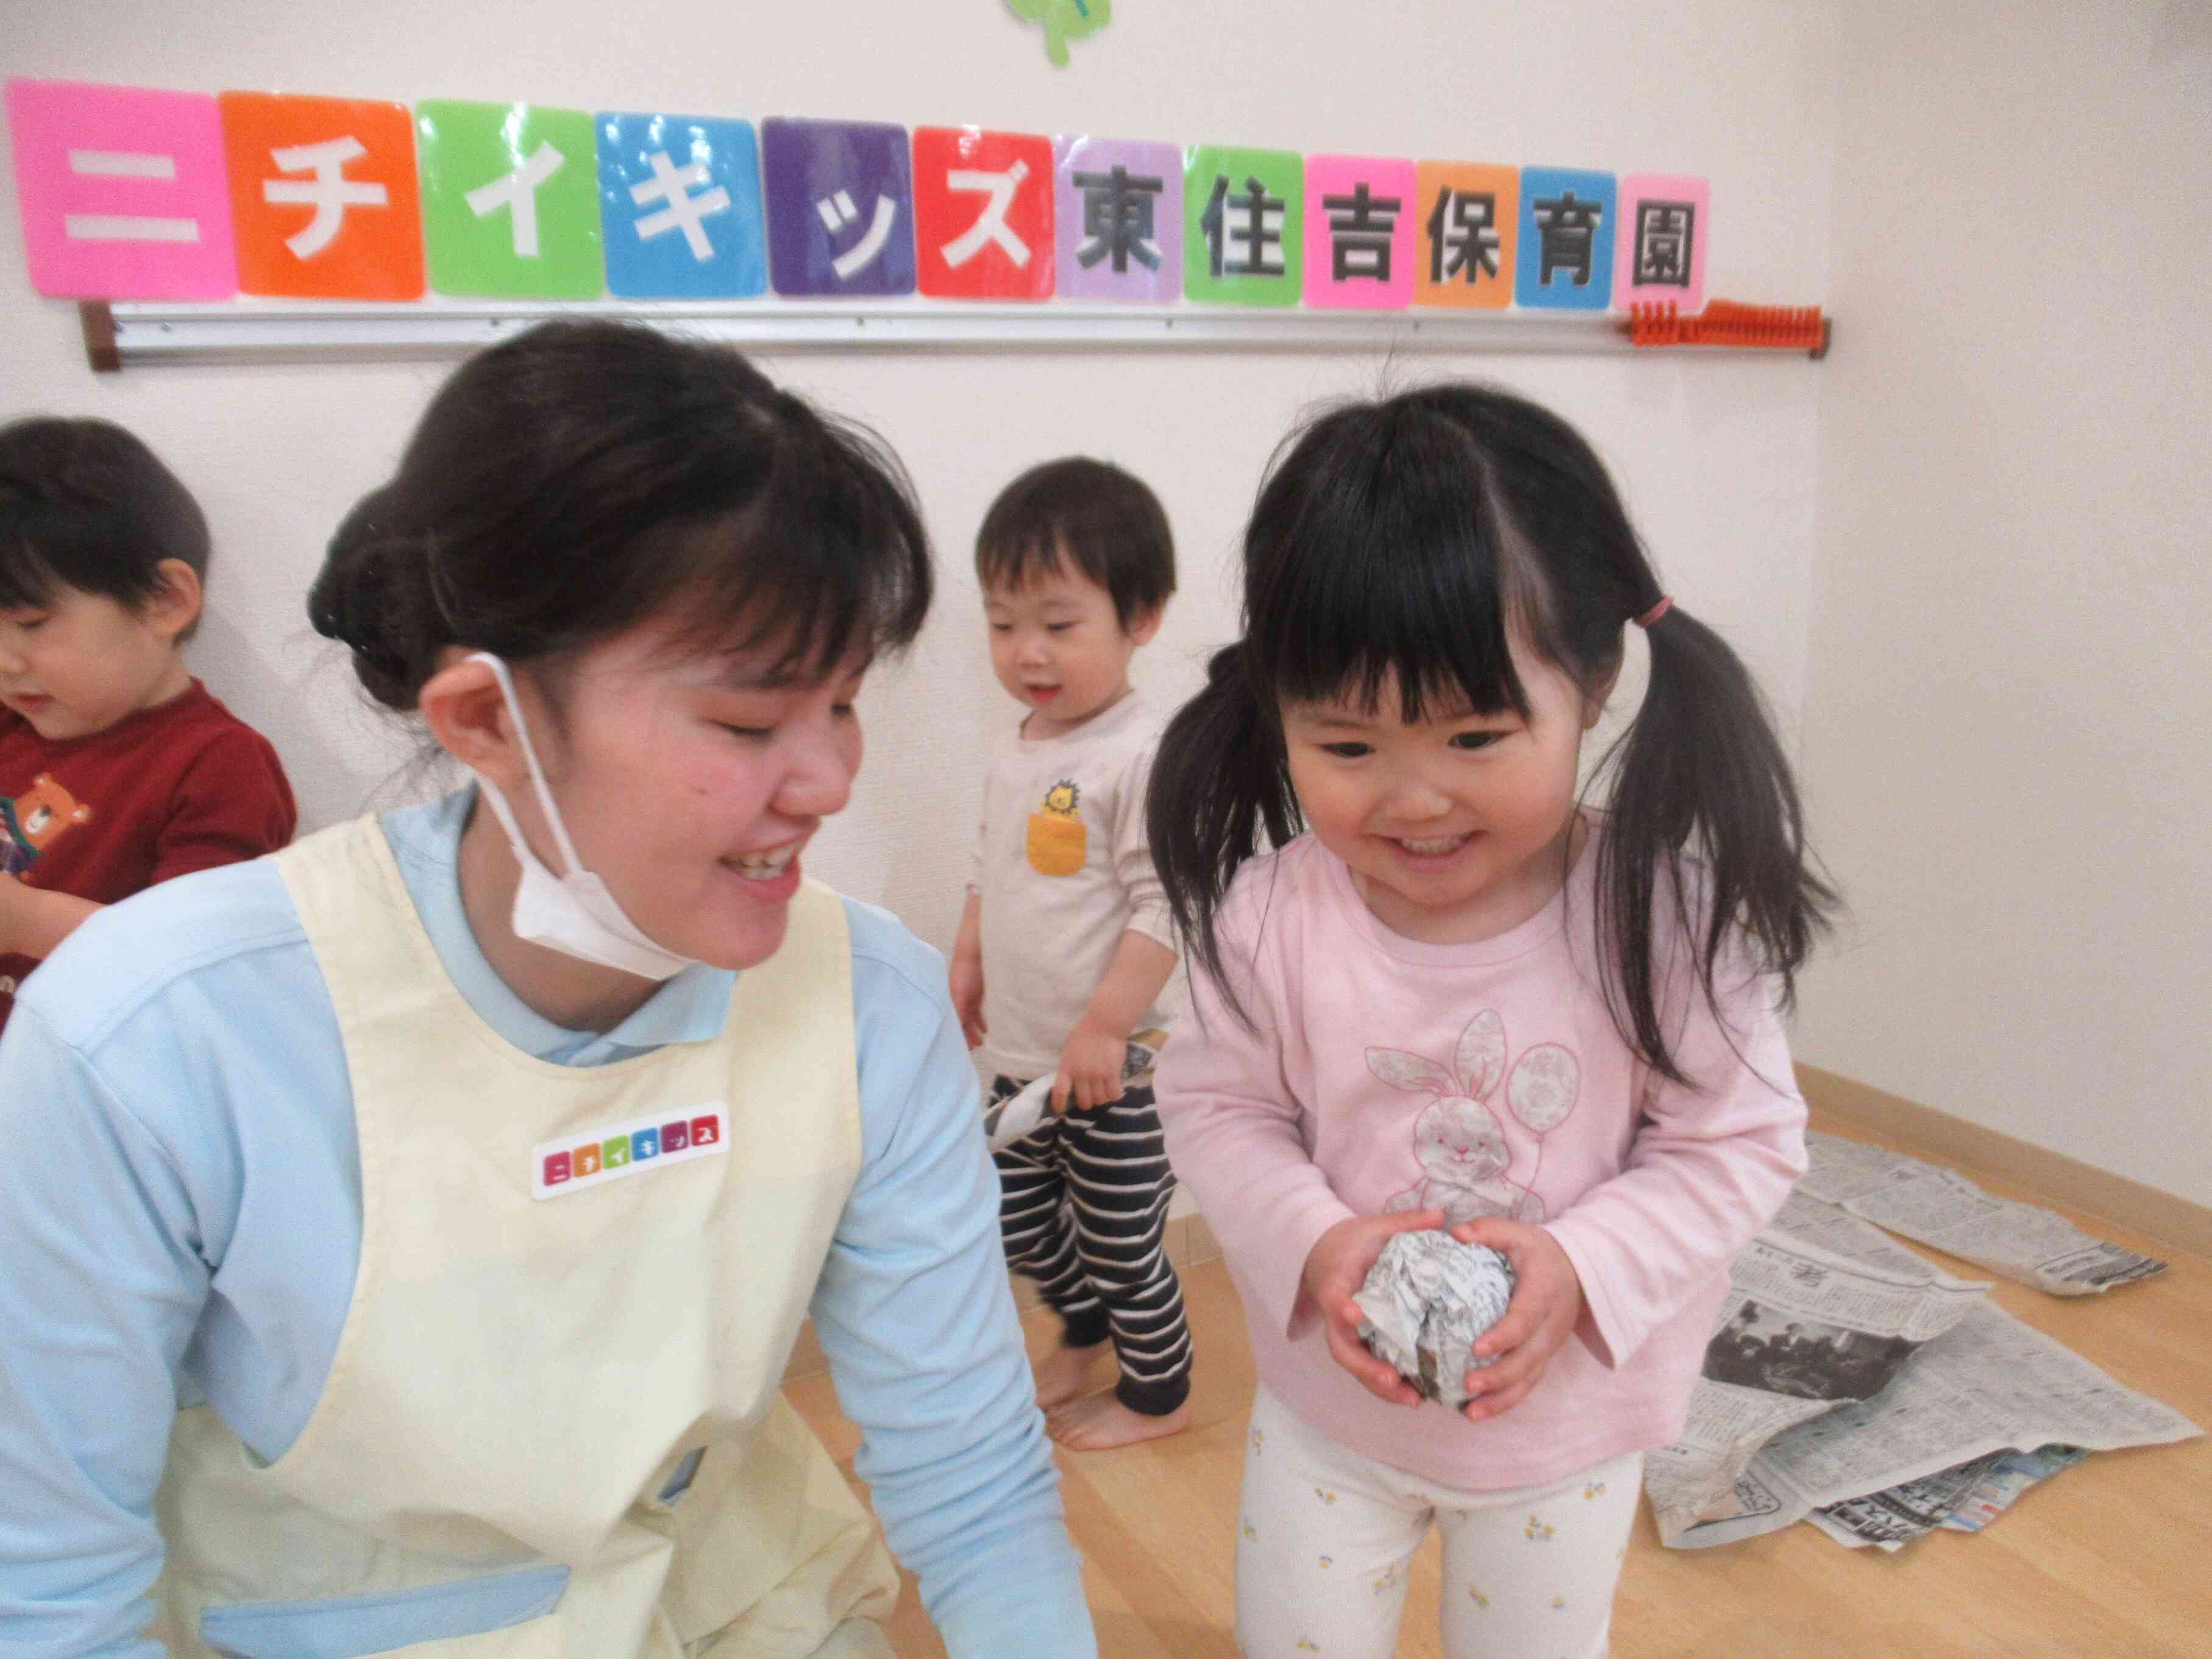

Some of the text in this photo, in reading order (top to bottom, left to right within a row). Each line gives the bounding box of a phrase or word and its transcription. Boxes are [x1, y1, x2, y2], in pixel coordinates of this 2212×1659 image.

[64, 135, 1699, 290] ニチイキッズ東住吉保育園
